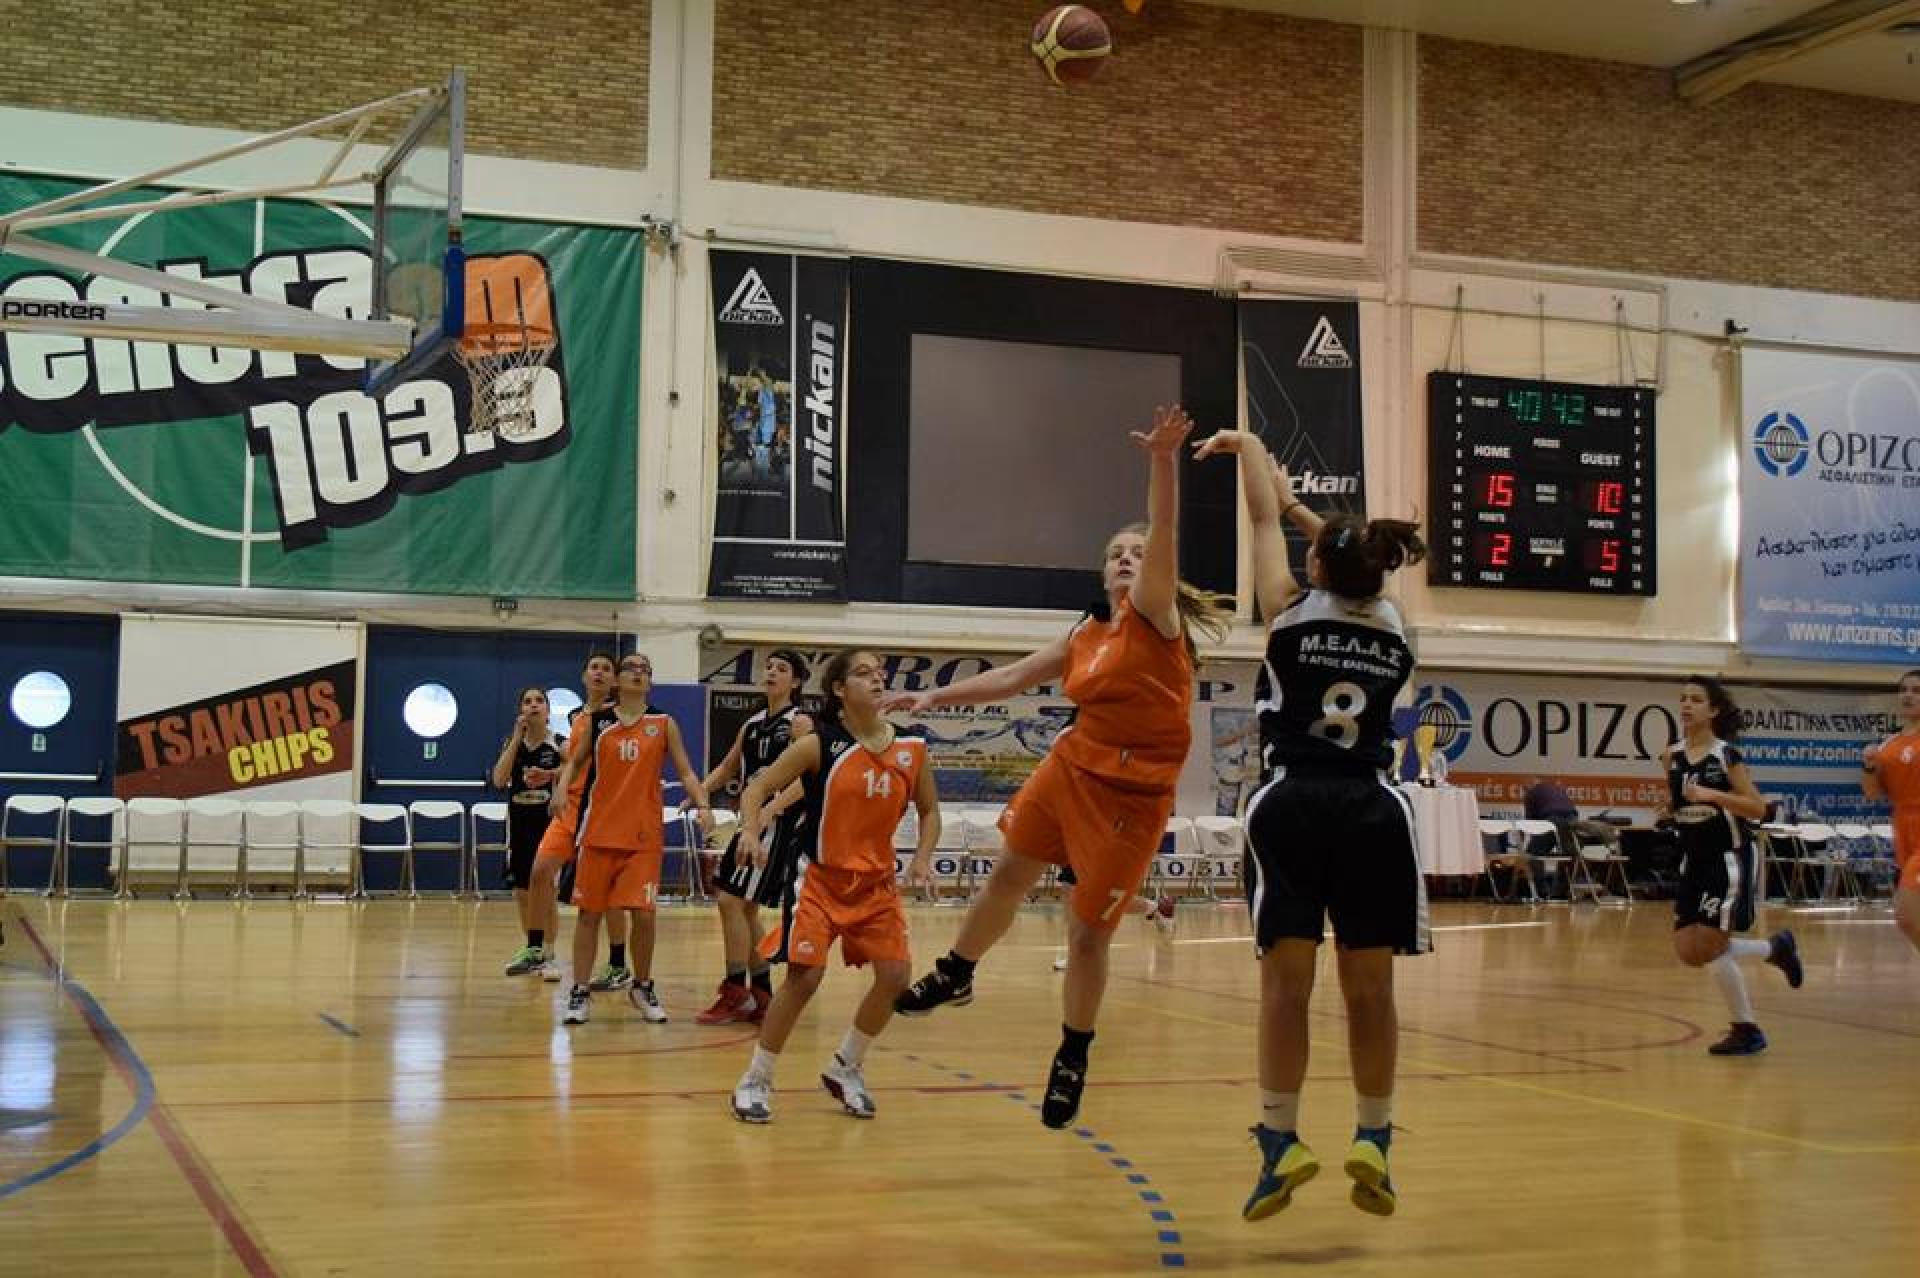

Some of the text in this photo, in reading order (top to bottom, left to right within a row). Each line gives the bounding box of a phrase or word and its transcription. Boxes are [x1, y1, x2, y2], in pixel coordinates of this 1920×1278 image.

[0, 248, 376, 401] entra
[804, 320, 835, 493] nickan
[1473, 444, 1511, 459] HOME
[1580, 453, 1621, 467] GUEST
[1288, 471, 1356, 494] ckan
[1487, 475, 1514, 507] 15
[1491, 533, 1511, 566] 2
[1599, 540, 1621, 573] 5
[128, 680, 343, 770] TSAKIRIS
[1308, 681, 1368, 750] 8
[227, 726, 335, 784] CHIPS
[616, 738, 640, 762] 16
[864, 768, 891, 799] 14
[1100, 889, 1127, 921] 7
